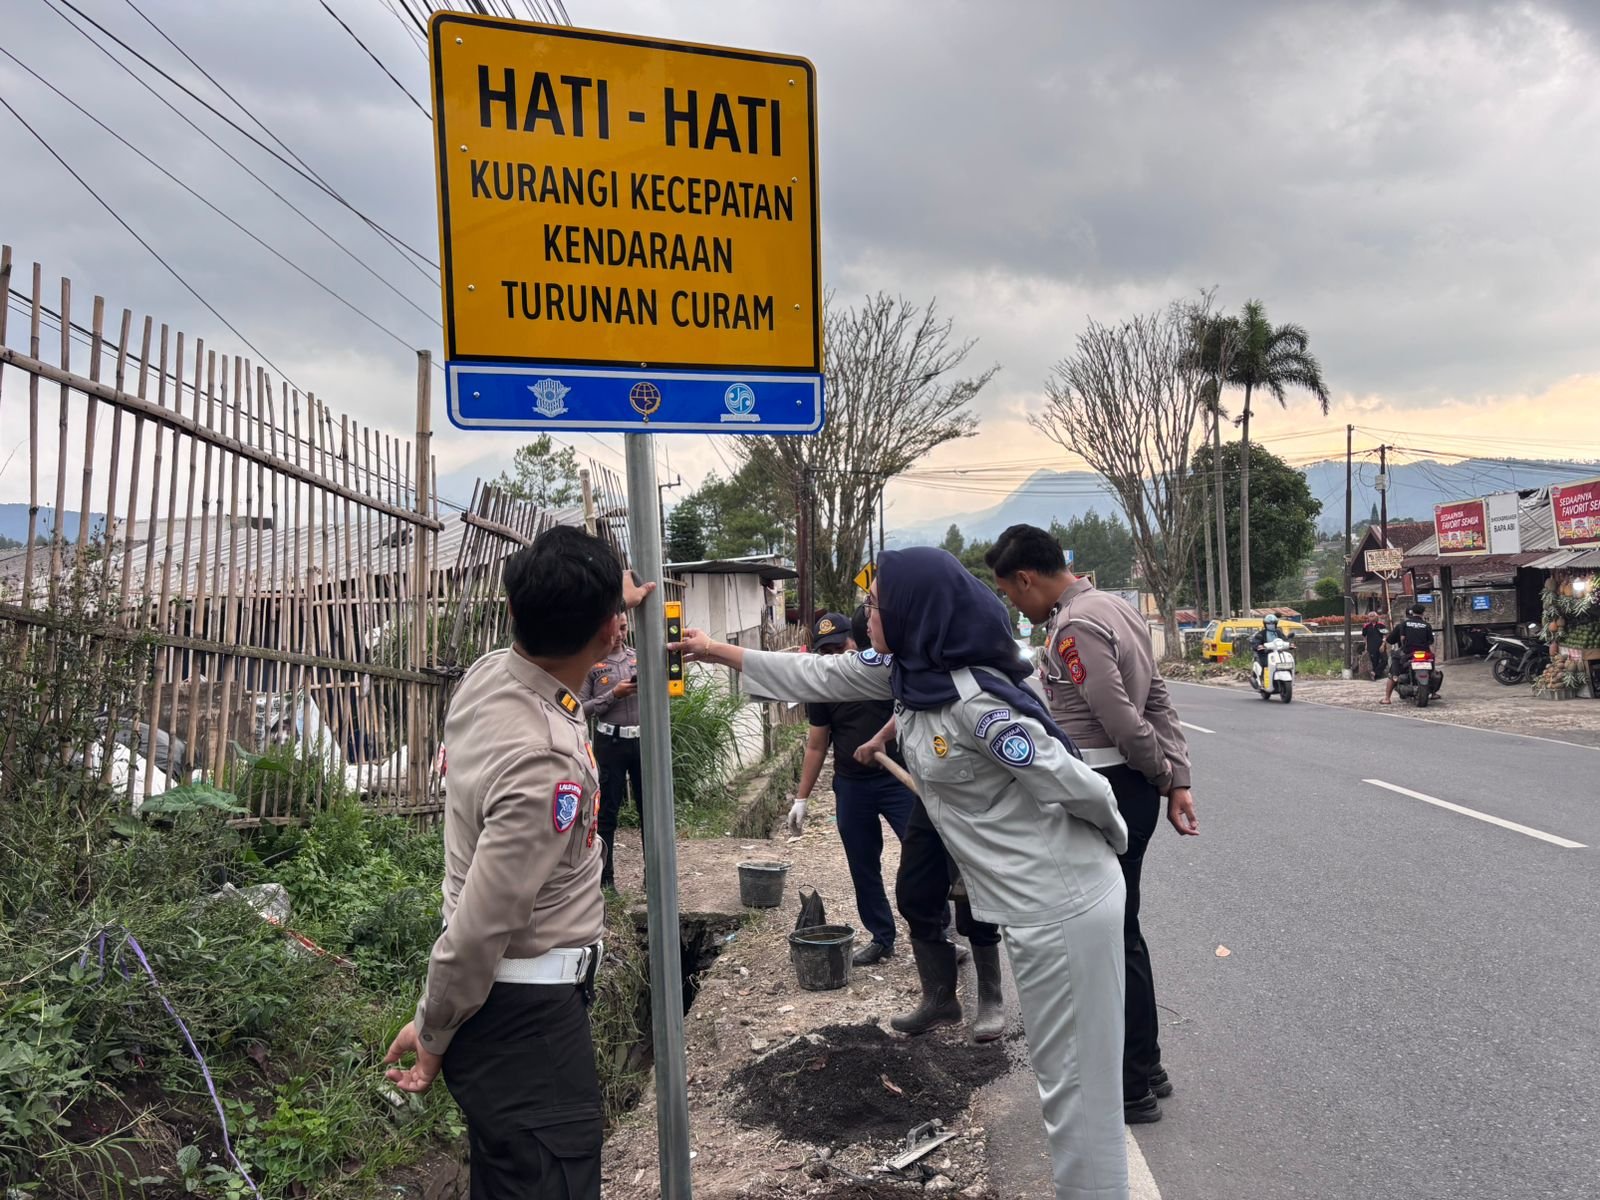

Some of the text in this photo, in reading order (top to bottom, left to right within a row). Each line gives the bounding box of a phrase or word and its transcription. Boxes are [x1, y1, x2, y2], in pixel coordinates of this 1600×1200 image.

[477, 64, 610, 140] HATI
[664, 87, 782, 157] HATI
[470, 159, 793, 222] KURANGI KECEPATAN
[543, 223, 733, 274] KENDARAAN
[500, 280, 774, 331] TURUNAN CURAM
[1562, 502, 1589, 517] FAVORIT
